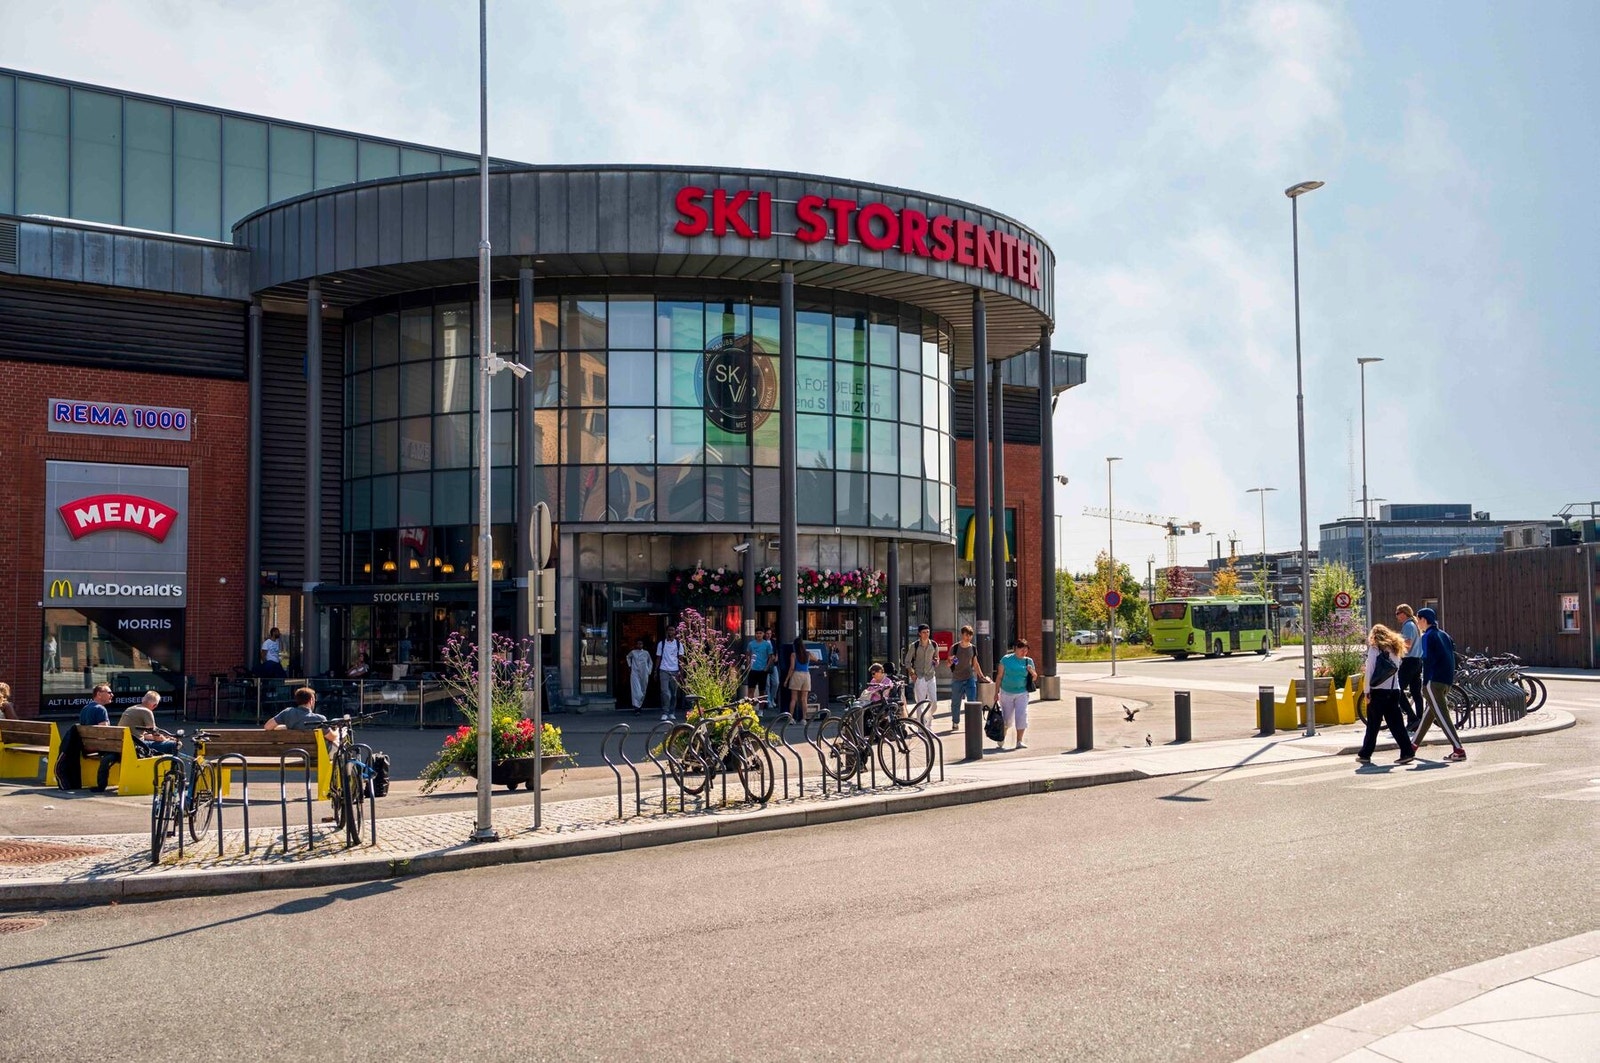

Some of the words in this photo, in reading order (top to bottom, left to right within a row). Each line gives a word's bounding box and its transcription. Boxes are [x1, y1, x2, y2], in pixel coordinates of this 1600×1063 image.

[674, 186, 772, 239] SKI
[795, 195, 1042, 290] STORSENTER
[805, 378, 880, 396] FORDELEE
[55, 402, 129, 427] REMA
[134, 408, 188, 431] 1000
[74, 502, 166, 529] MENY
[77, 583, 183, 597] McDonald's
[373, 592, 440, 602] STOCKFLETHS
[118, 619, 172, 630] MORRIS
[67, 698, 95, 706] LÆRVA
[115, 696, 173, 704] REISEETER
